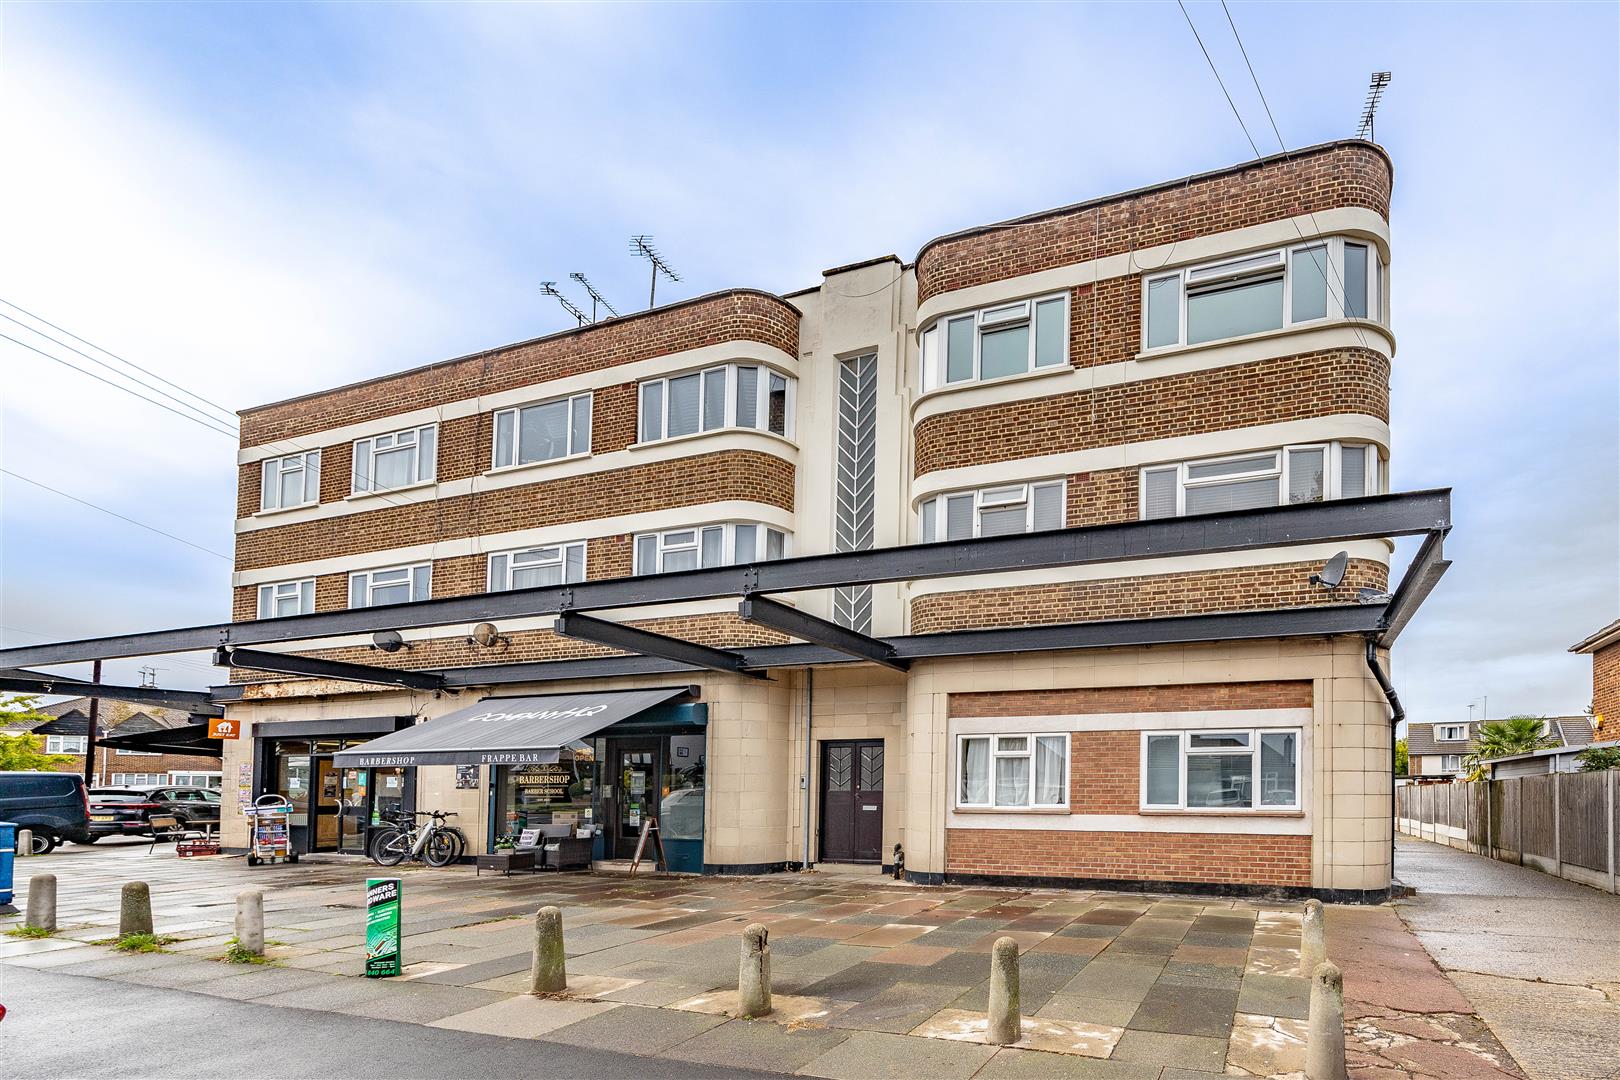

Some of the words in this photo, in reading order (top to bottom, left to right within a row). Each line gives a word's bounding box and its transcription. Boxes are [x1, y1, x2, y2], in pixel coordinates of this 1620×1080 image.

[359, 756, 416, 766] BARBERSHOP
[481, 754, 517, 763] FRAPPE
[519, 753, 539, 762] BAR
[519, 775, 571, 784] BARBERSHOP
